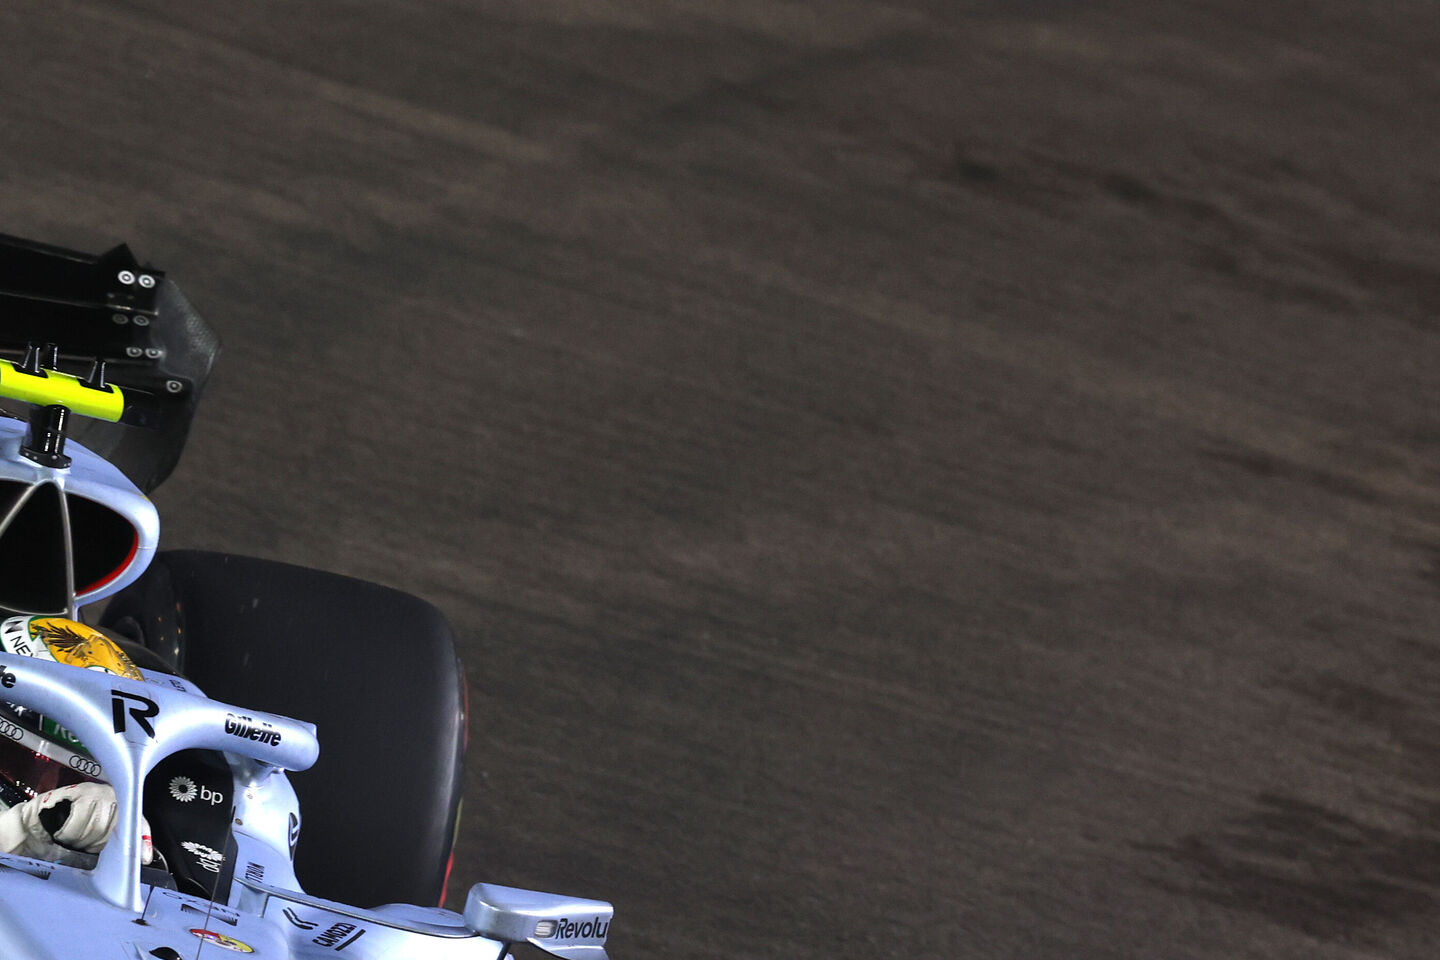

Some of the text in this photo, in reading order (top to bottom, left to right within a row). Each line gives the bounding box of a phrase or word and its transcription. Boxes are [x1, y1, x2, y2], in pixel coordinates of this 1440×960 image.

[10, 635, 34, 657] NE
[224, 712, 282, 747] Gillette
[200, 785, 224, 806] bp
[312, 922, 358, 948] CAMOZZI
[555, 916, 608, 940] Revolu
